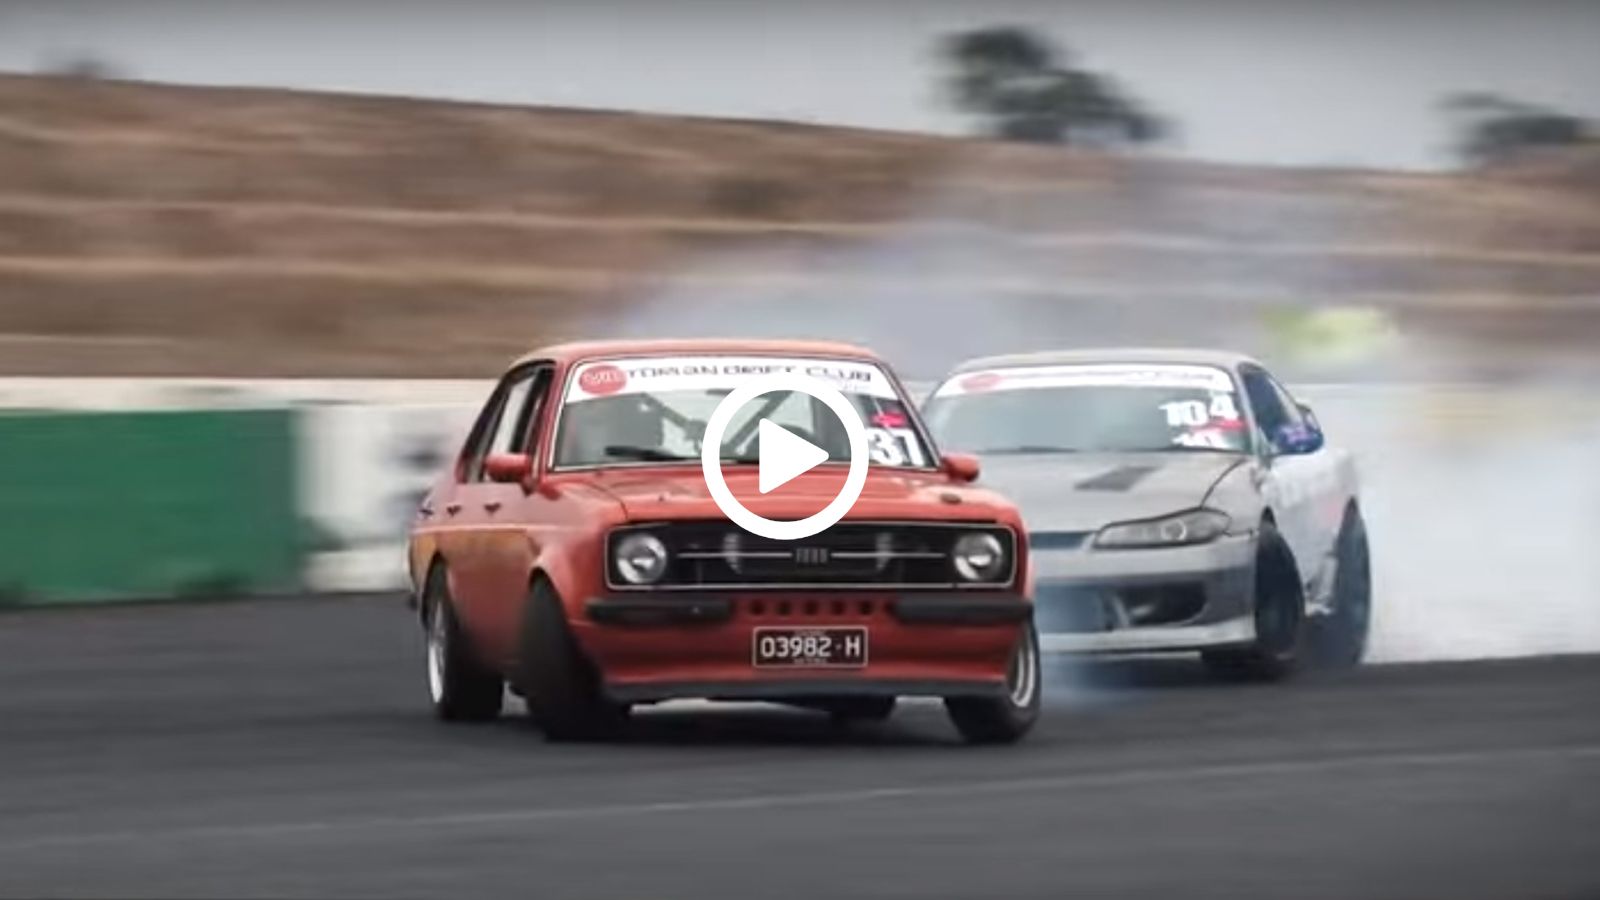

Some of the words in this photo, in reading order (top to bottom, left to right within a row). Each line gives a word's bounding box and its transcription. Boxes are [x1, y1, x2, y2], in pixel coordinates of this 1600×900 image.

[806, 365, 871, 382] CLUB
[1158, 394, 1239, 427] 104
[865, 427, 925, 466] 37
